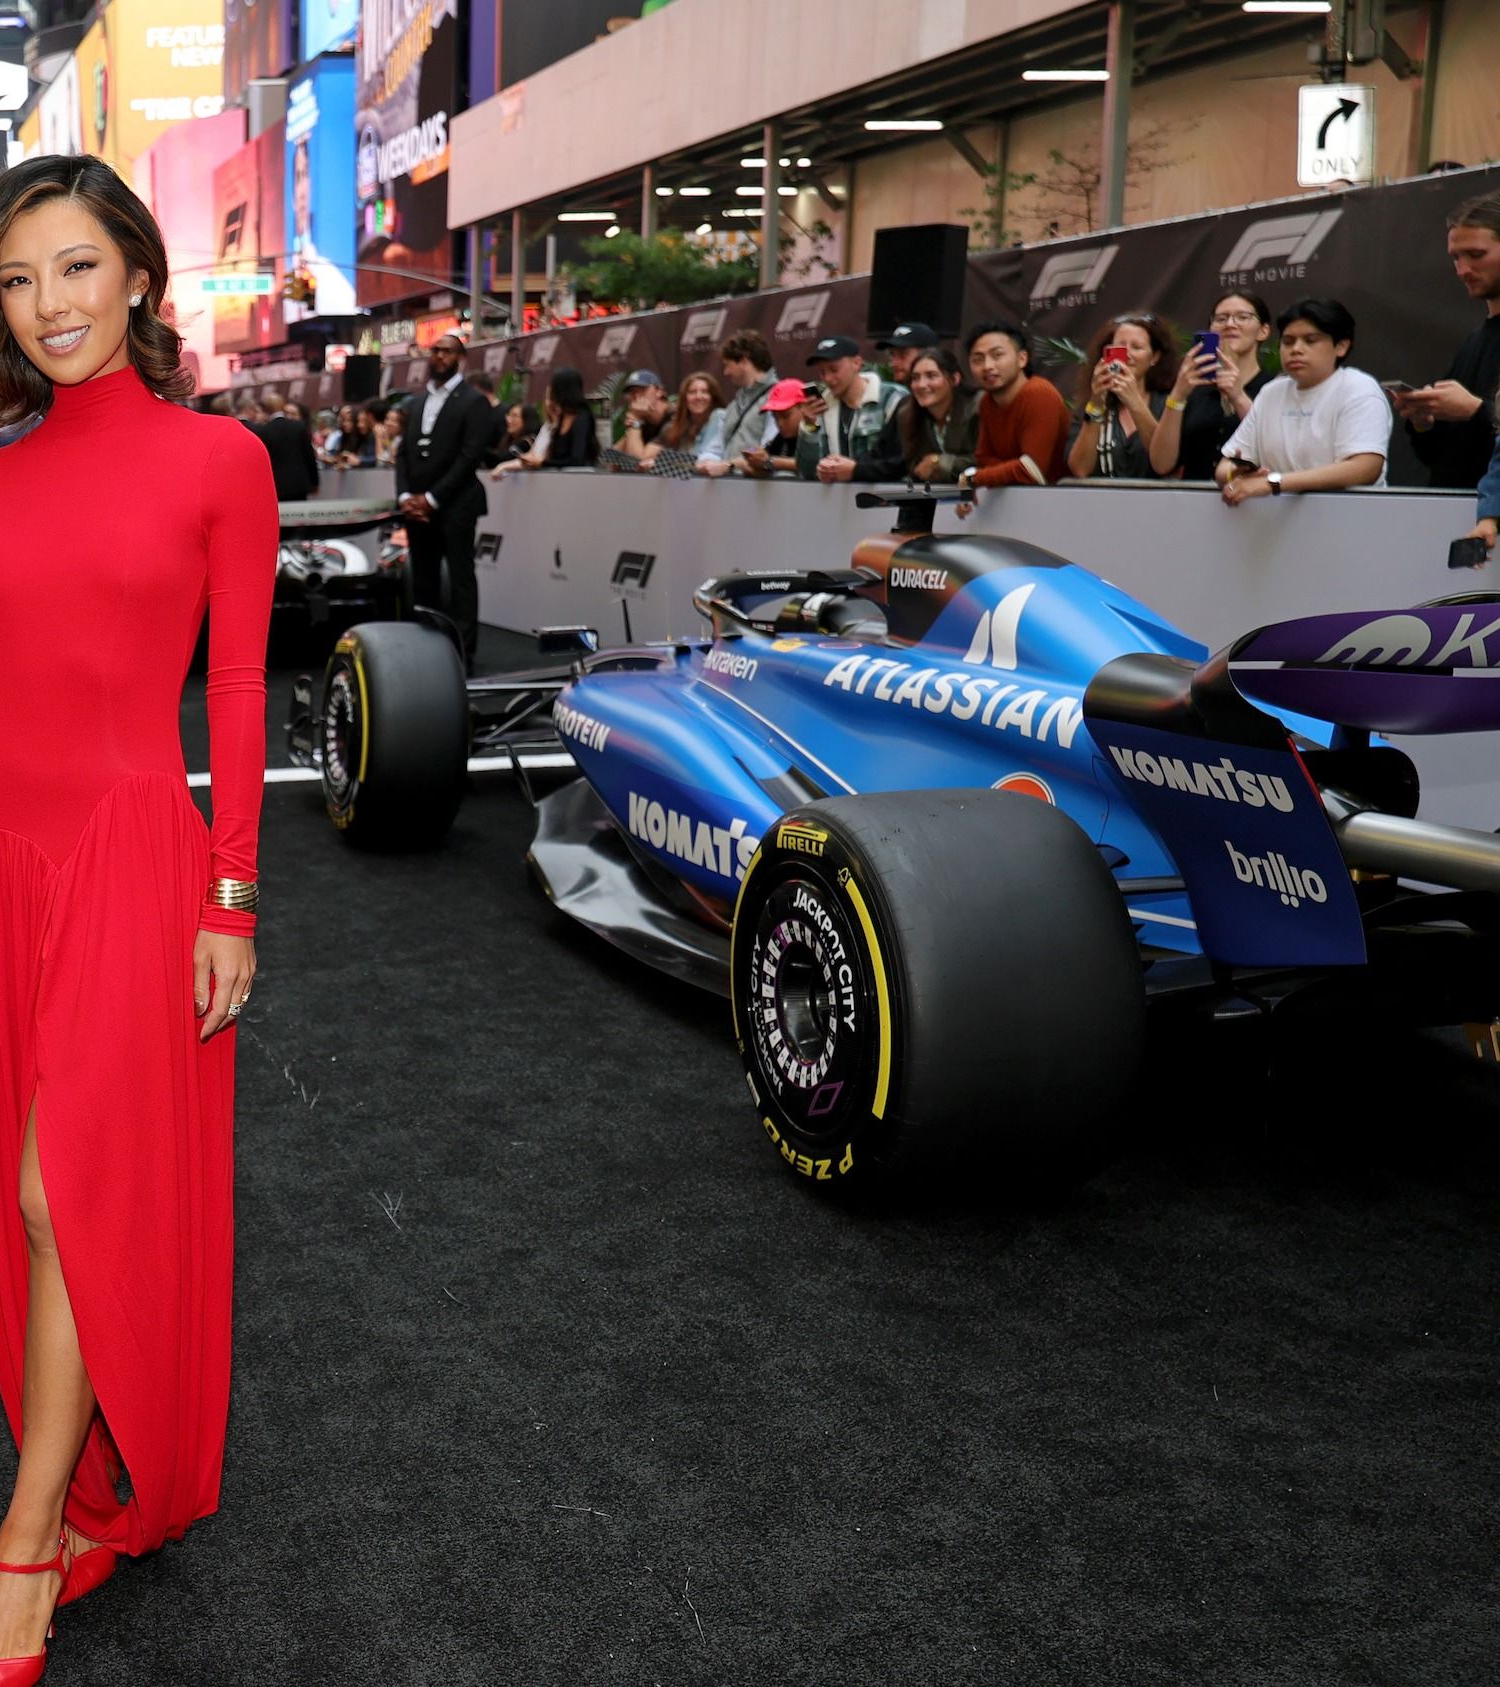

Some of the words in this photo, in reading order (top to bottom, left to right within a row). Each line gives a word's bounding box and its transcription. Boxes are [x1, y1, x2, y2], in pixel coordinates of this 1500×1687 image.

[377, 110, 448, 184] WEEKDAYS
[1311, 157, 1363, 176] ONLY
[1219, 273, 1248, 287] THE
[1254, 266, 1307, 283] MOVIE
[1029, 299, 1052, 311] THE
[1057, 294, 1098, 308] MOVIE
[760, 581, 791, 592] betway
[891, 567, 948, 591] DURACELL
[823, 654, 1084, 750] ATLASSIAN
[1108, 745, 1295, 813] KOMATSU
[777, 825, 829, 857] PIRELLI
[793, 887, 846, 961] JACKPOT
[838, 964, 856, 1032] CITY
